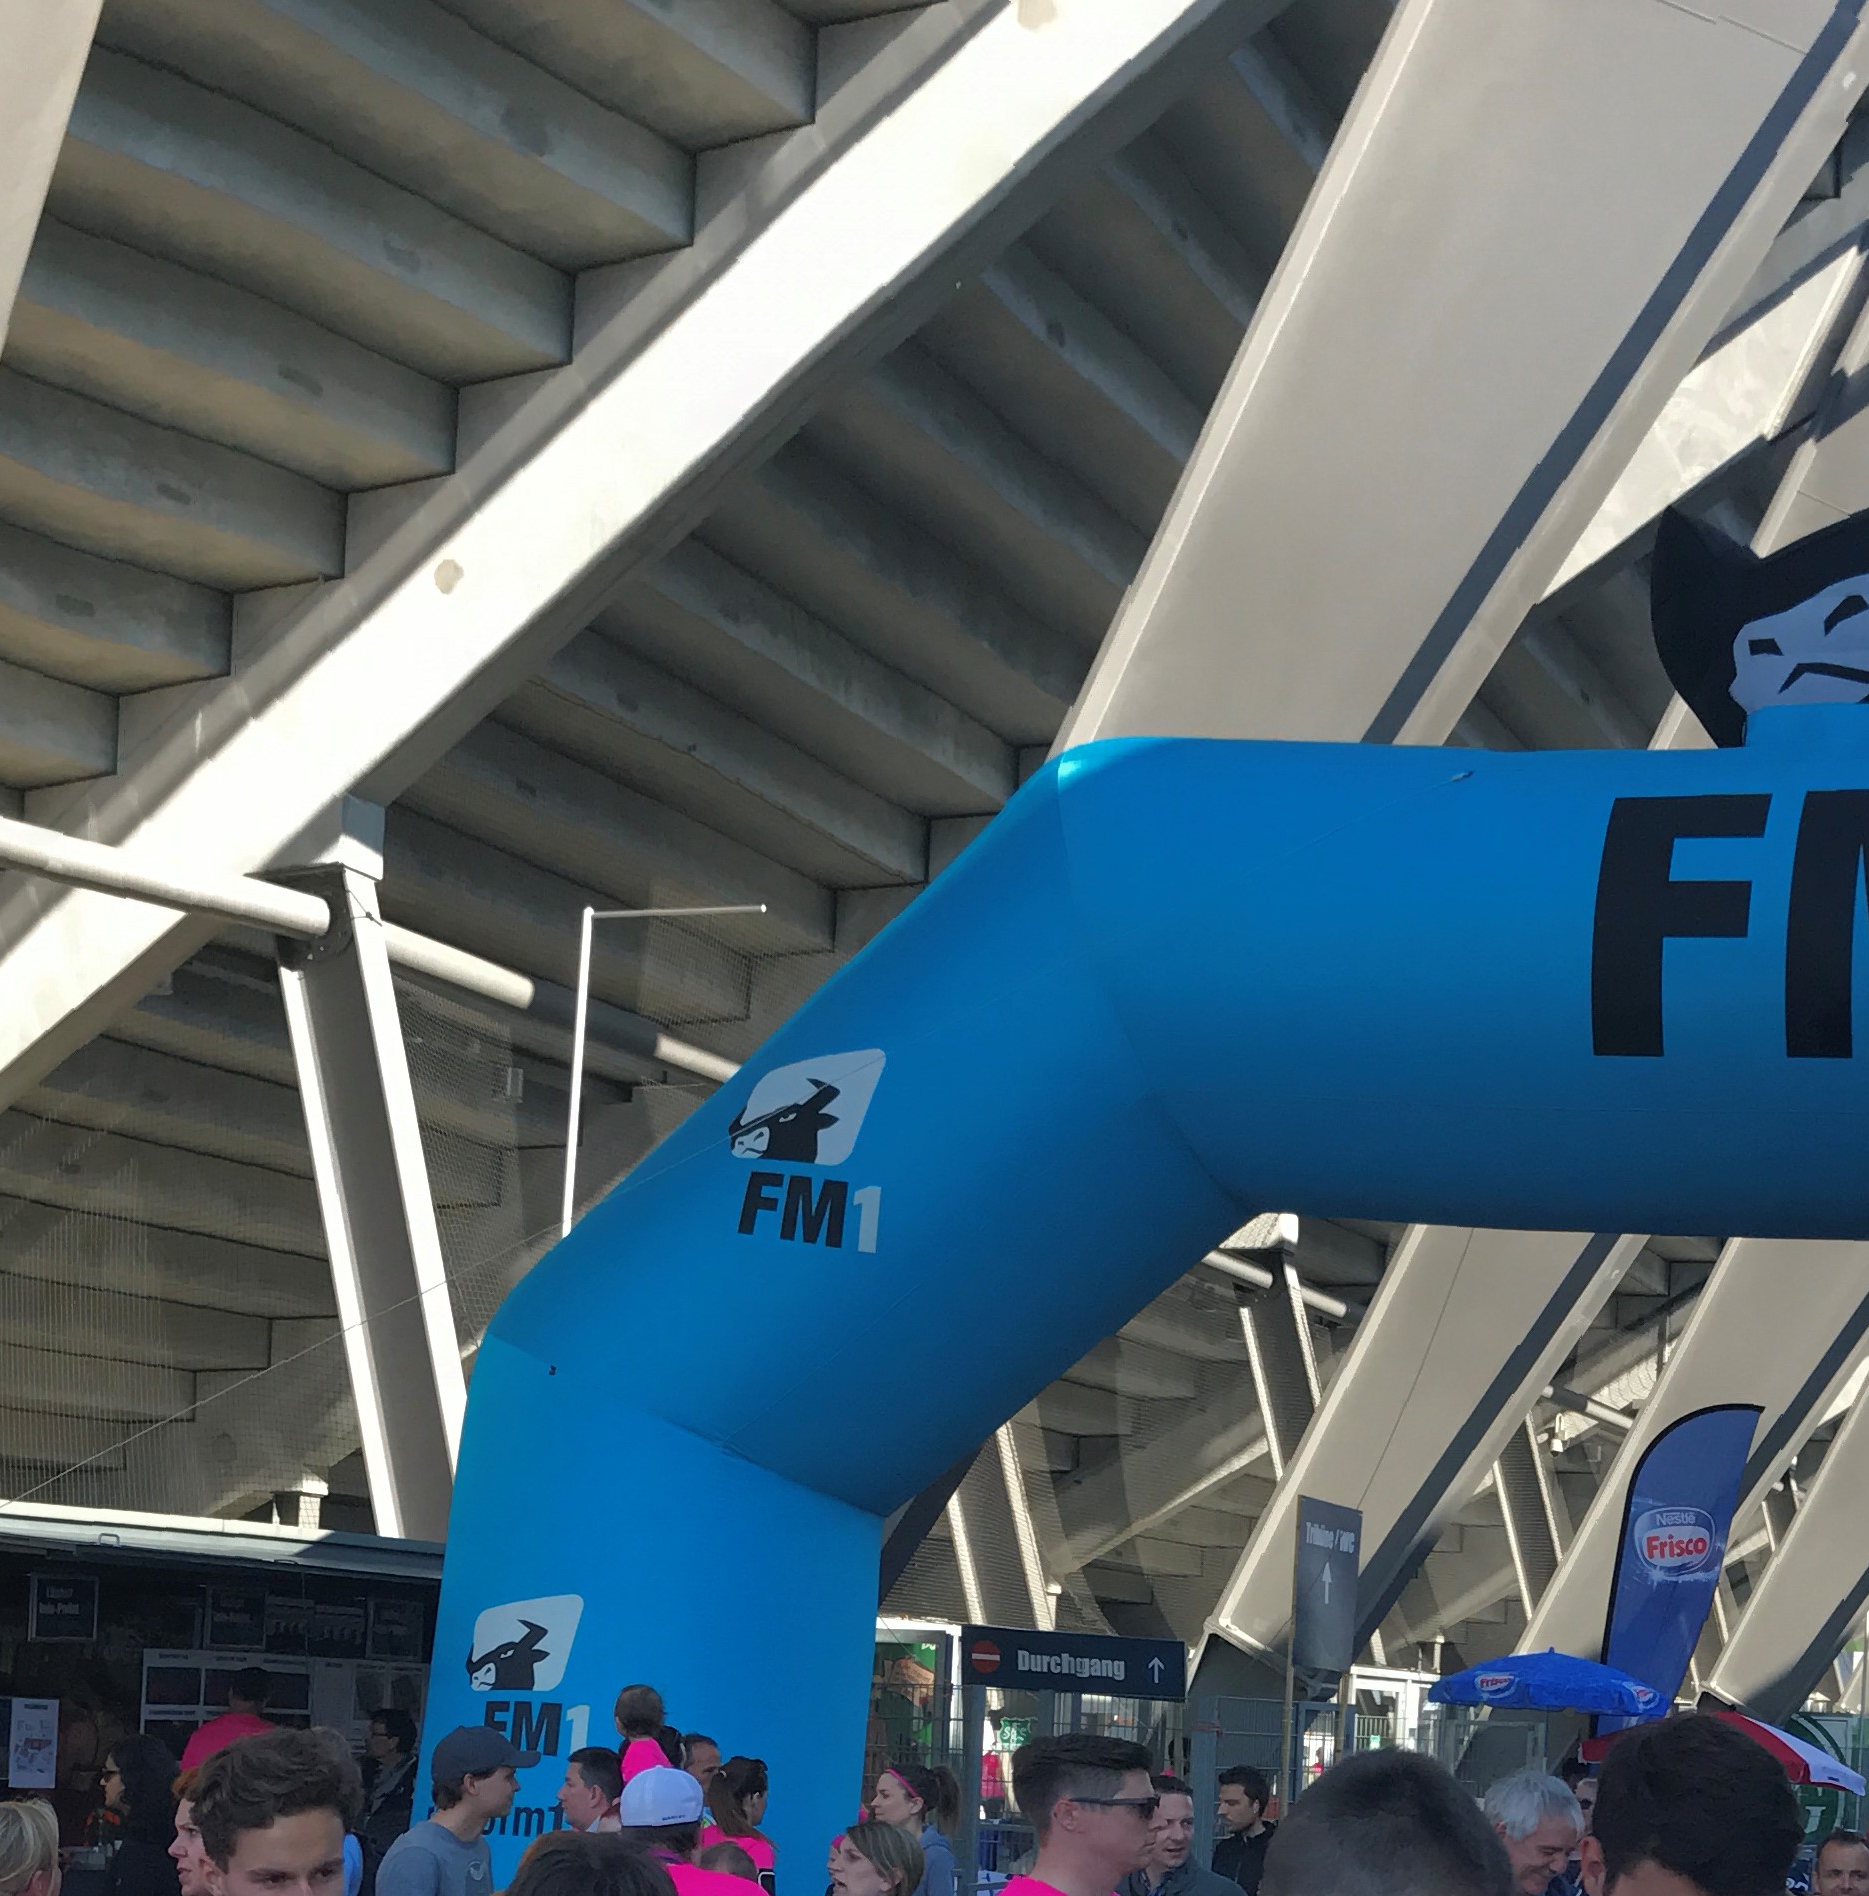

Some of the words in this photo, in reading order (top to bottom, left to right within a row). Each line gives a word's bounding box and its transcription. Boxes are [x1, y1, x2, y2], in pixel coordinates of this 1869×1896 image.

[737, 1171, 882, 1253] FM1
[1646, 1534, 1708, 1559] Frisco
[1017, 1650, 1126, 1681] Durchgang
